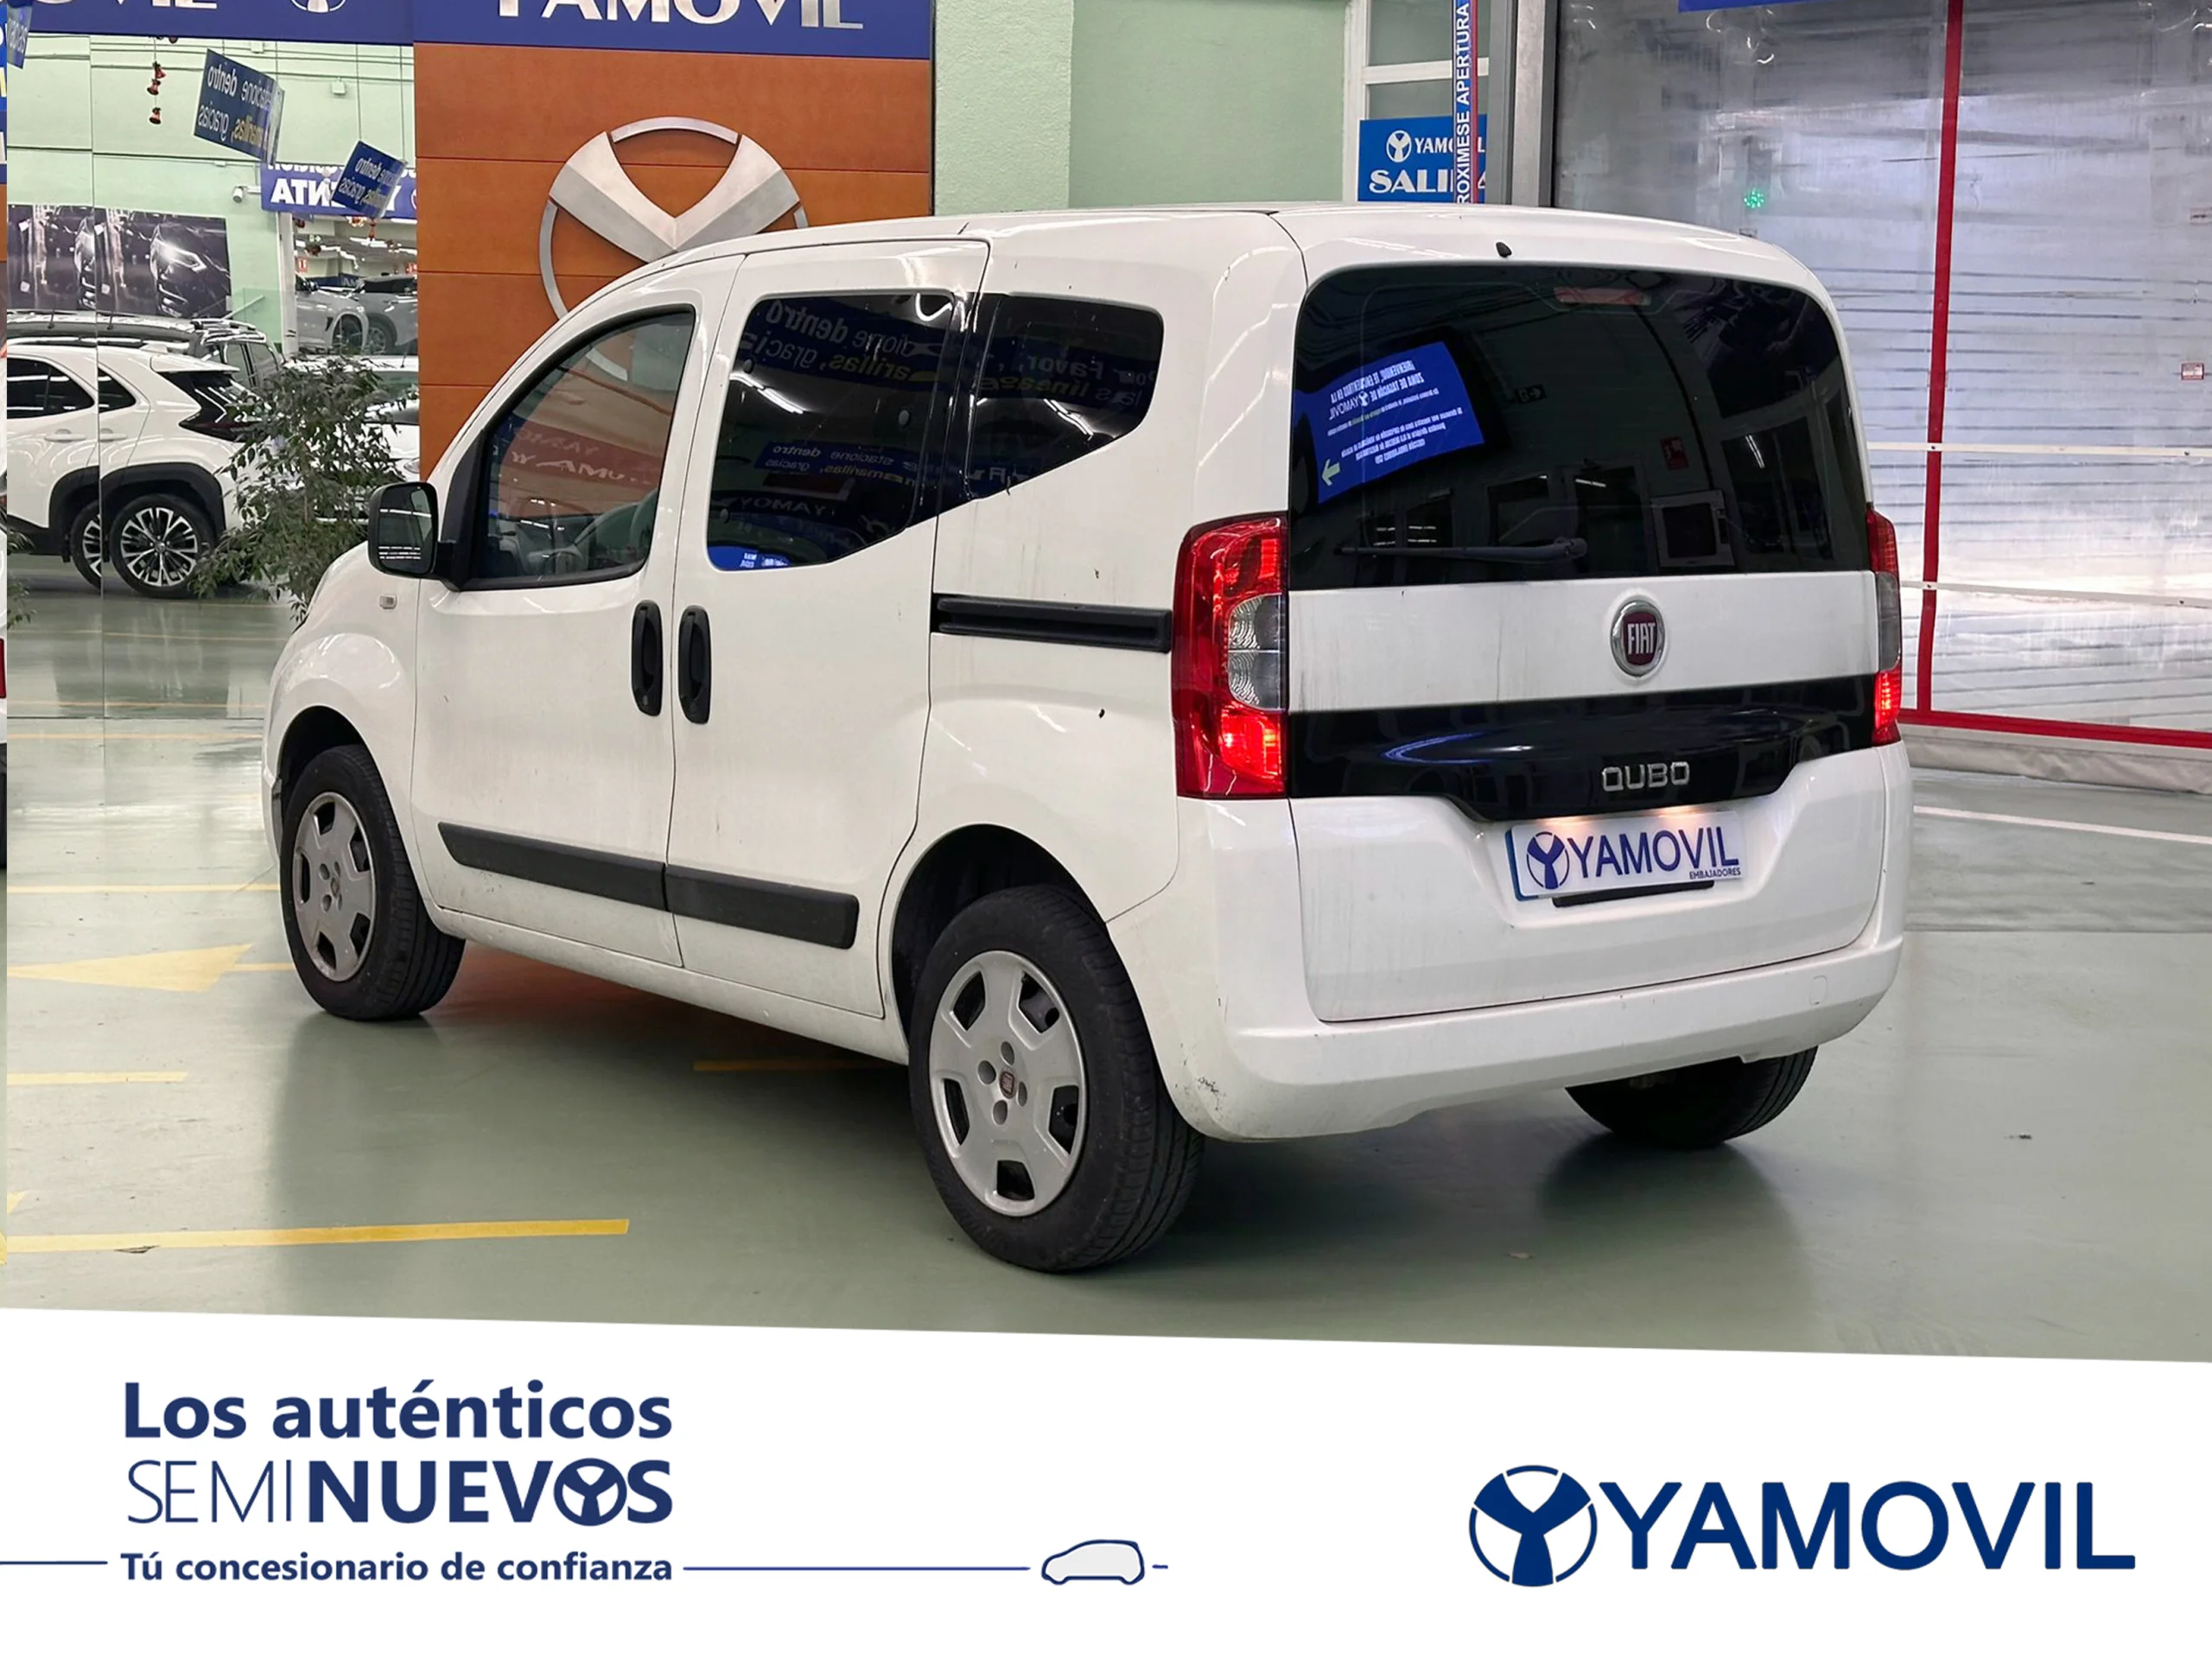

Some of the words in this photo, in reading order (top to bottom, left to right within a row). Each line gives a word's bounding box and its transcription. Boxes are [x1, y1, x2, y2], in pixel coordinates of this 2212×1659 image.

[1457, 3, 1470, 105] APERTURA
[1627, 622, 1656, 655] FIAT
[1602, 761, 1690, 792] QUBO
[1567, 826, 1739, 878] YAMOVIL
[1688, 867, 1742, 880] EMBAJADORES
